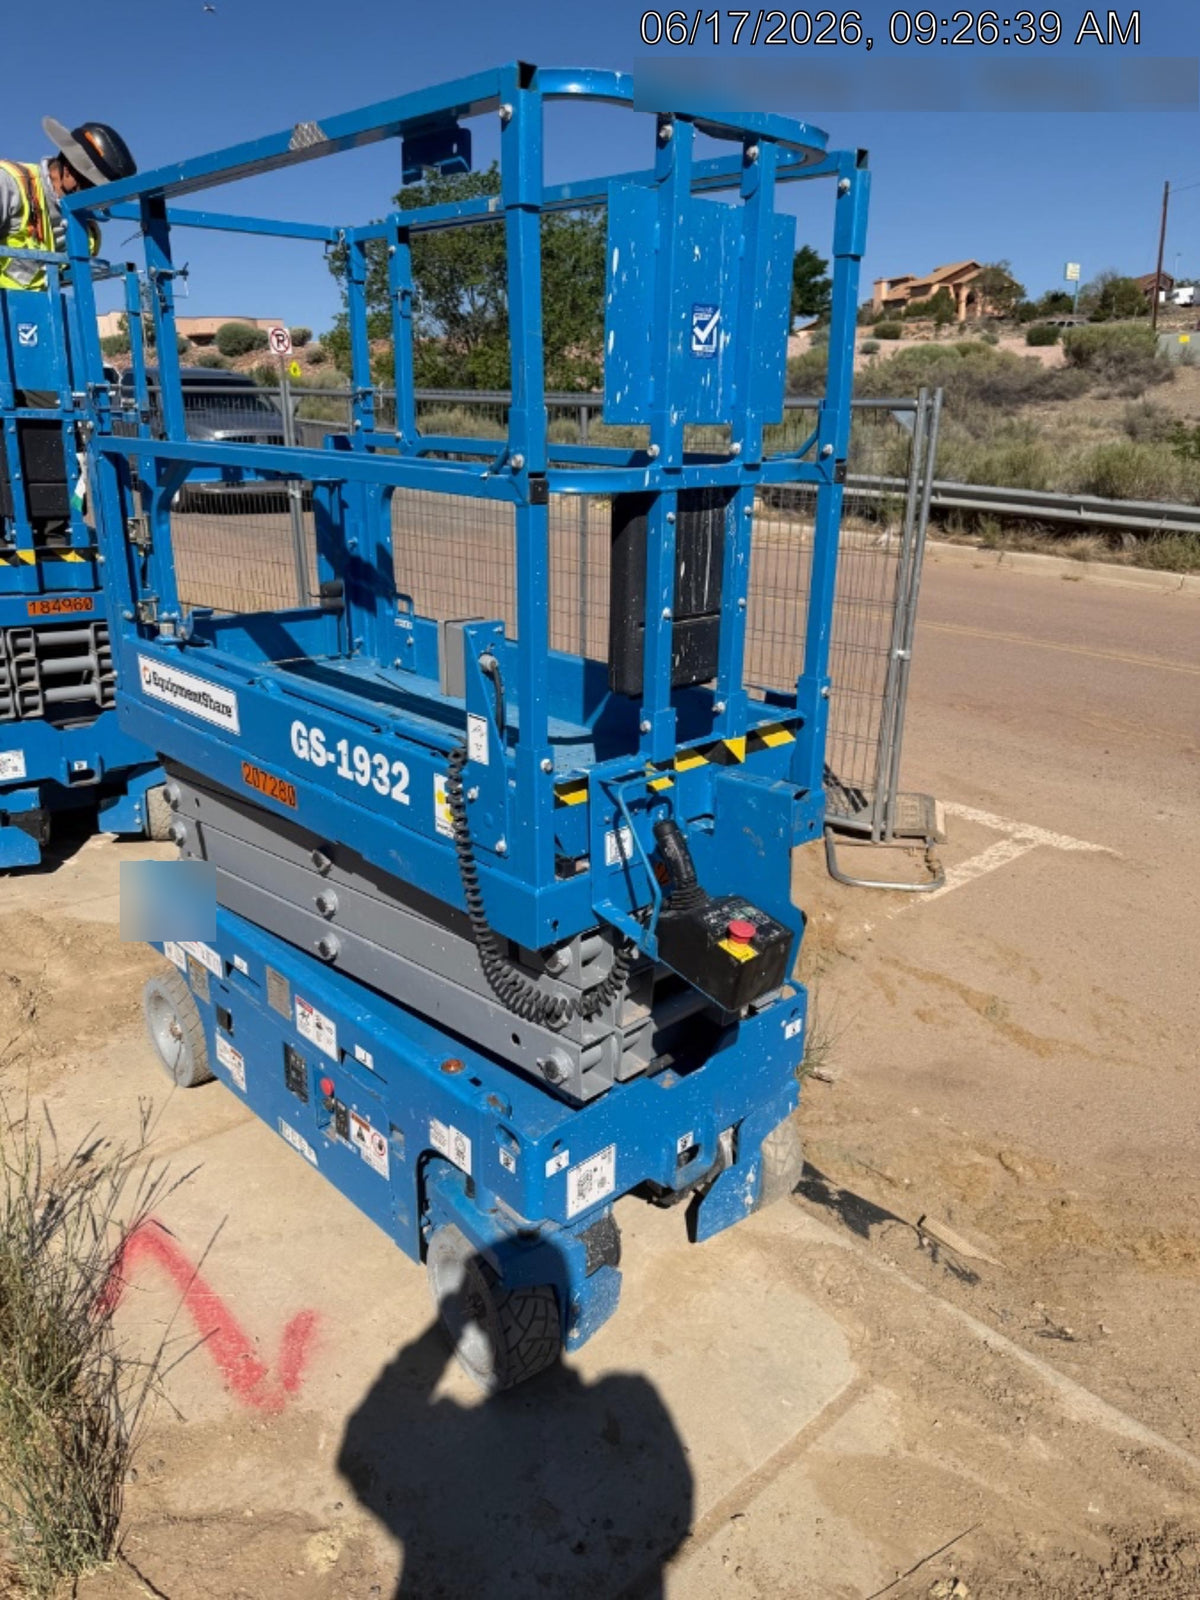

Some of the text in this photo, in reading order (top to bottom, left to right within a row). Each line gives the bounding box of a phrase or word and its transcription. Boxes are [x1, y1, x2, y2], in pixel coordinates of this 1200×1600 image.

[152, 671, 232, 718] EquipmentShare
[243, 762, 296, 808] 207280
[290, 719, 410, 806] GS-1932
